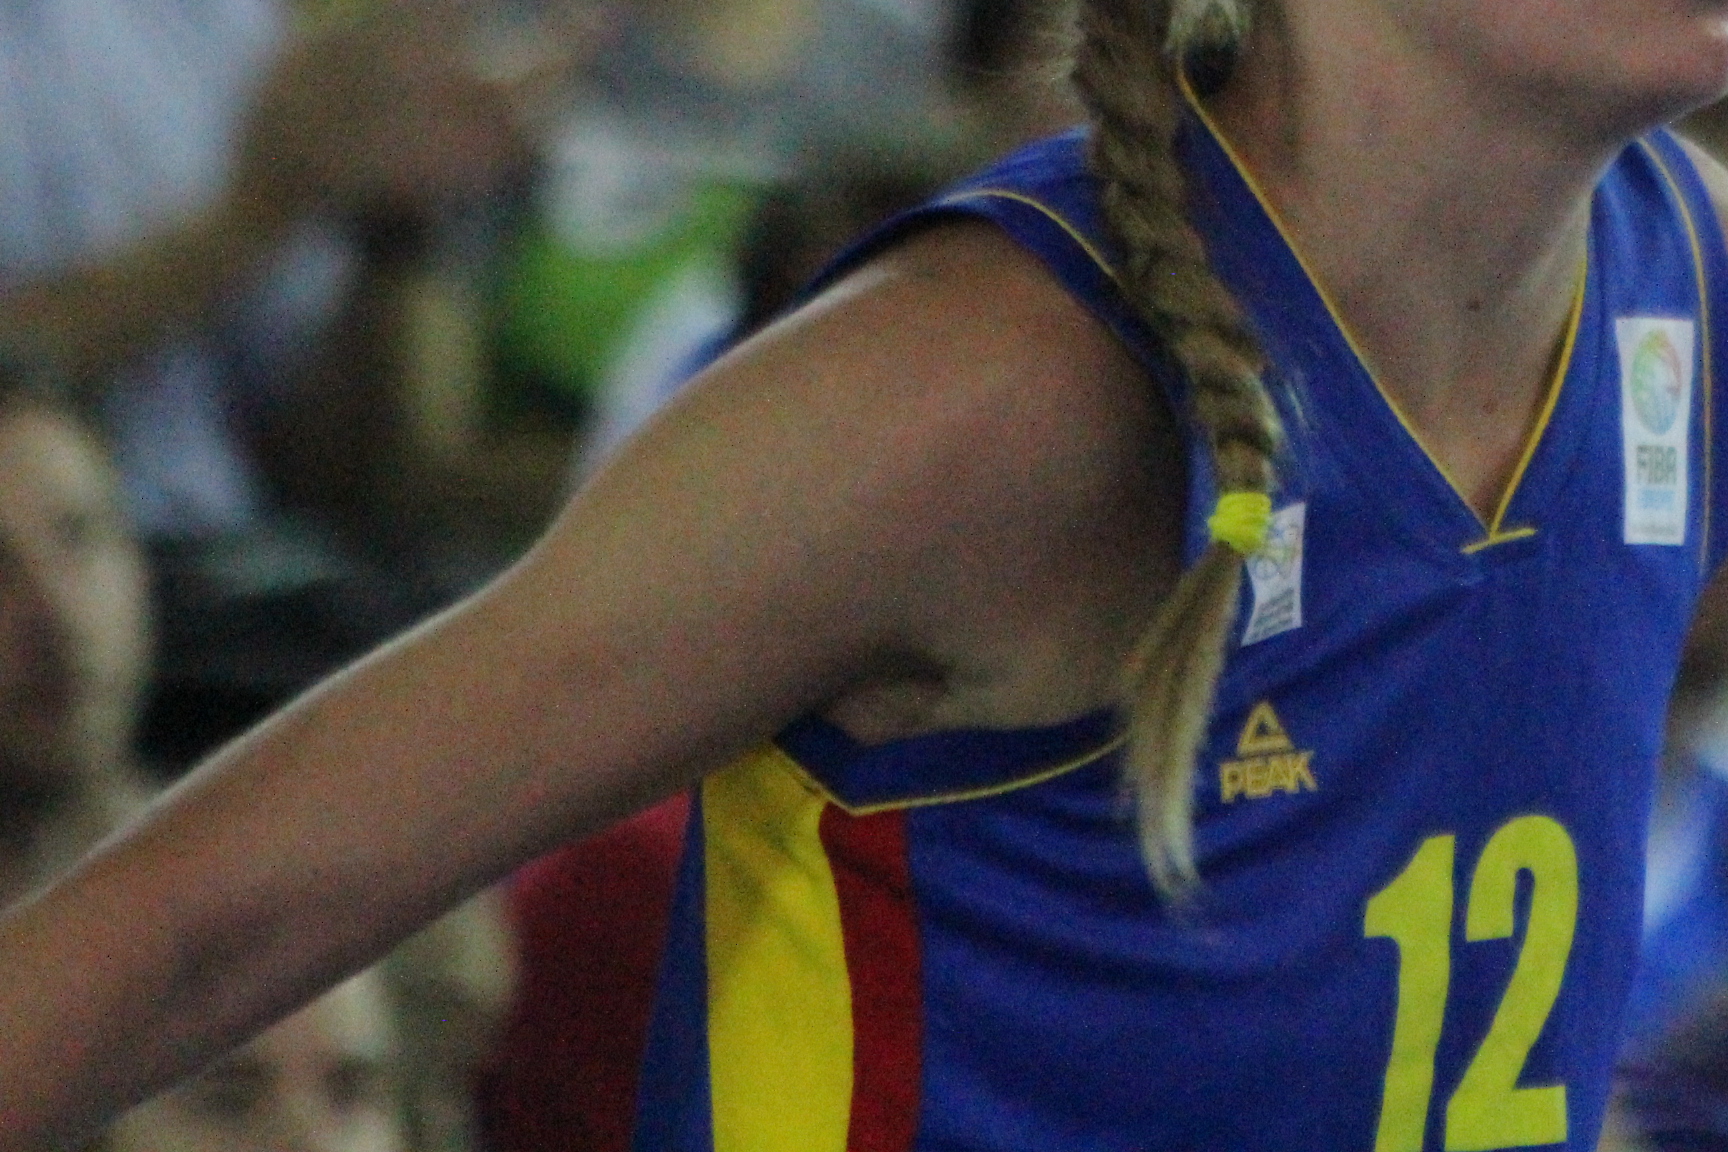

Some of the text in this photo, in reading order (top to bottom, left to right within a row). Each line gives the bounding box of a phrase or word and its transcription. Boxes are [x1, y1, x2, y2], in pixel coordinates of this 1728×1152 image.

[1636, 445, 1678, 485] FIBA
[1220, 751, 1318, 803] PEAK
[1364, 815, 1578, 1152] 12
